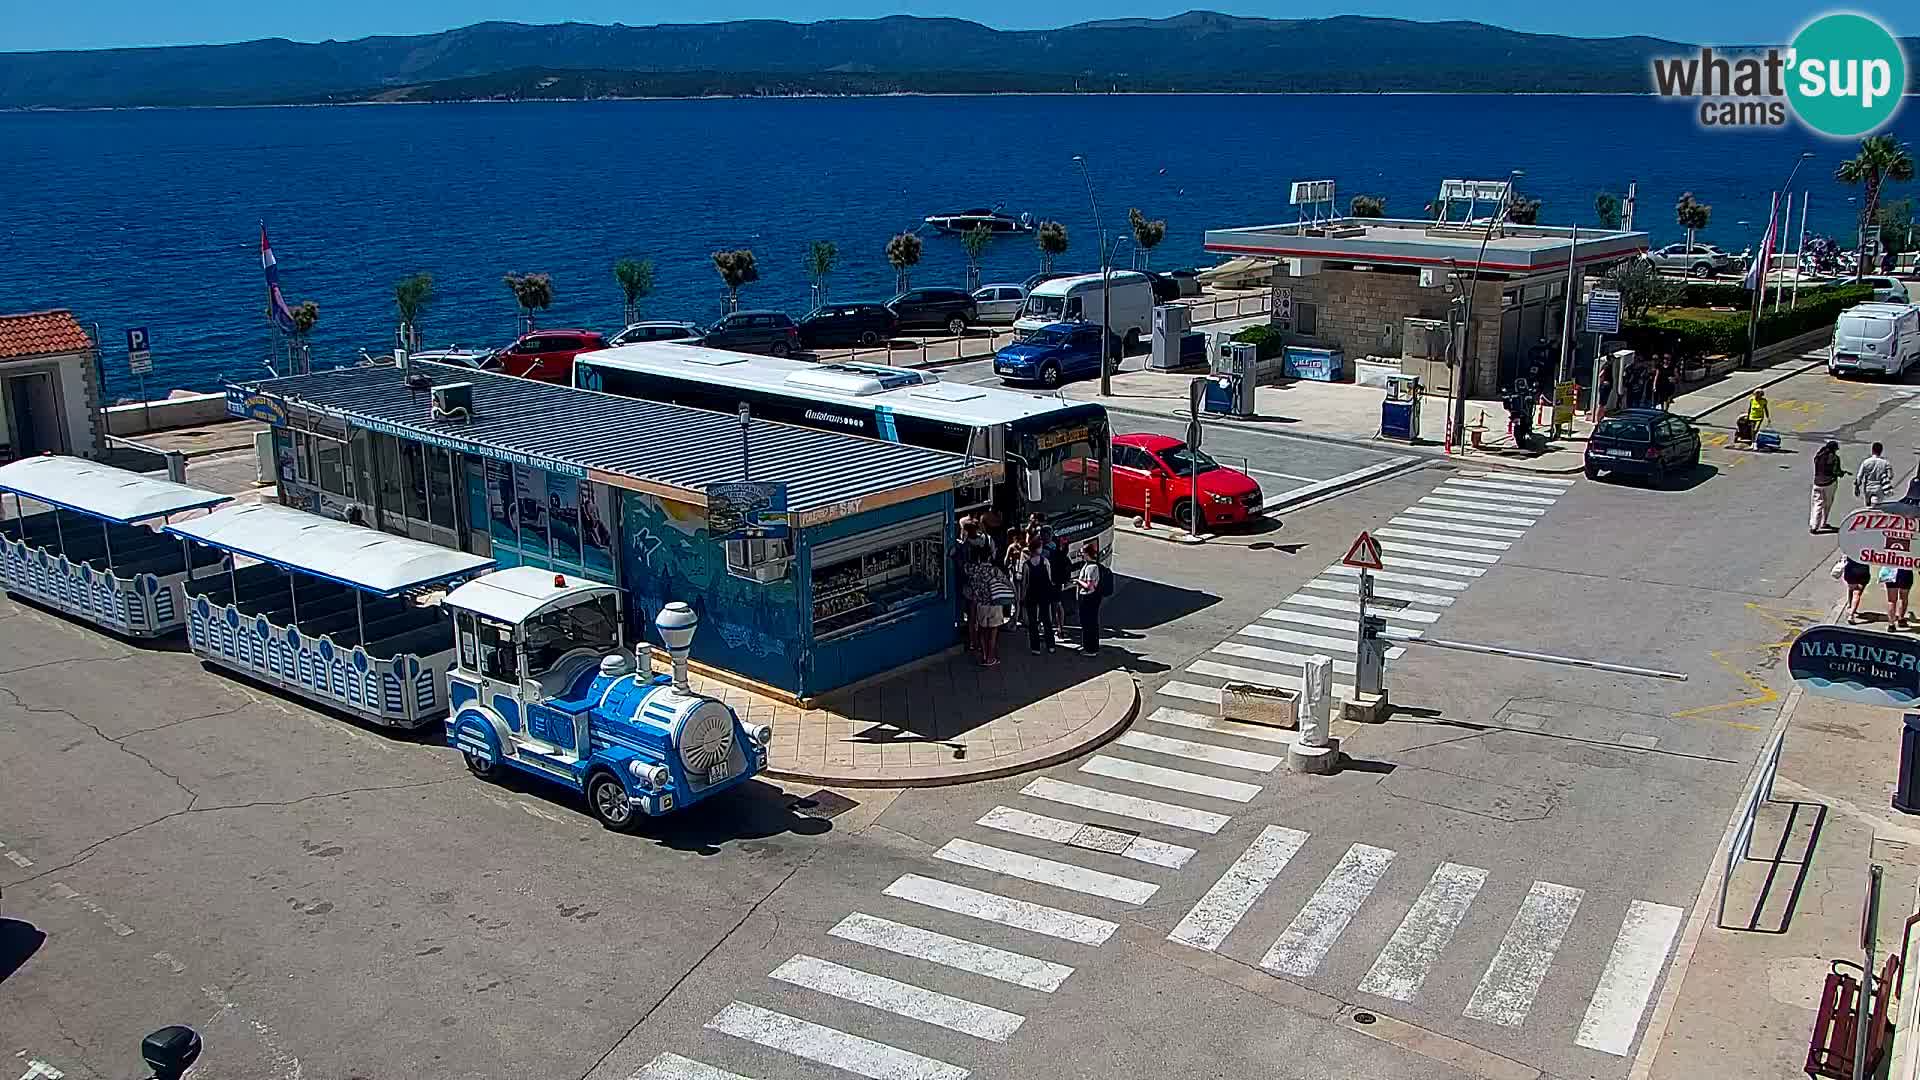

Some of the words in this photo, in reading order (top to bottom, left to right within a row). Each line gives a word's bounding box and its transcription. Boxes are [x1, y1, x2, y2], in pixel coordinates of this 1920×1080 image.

[131, 331, 143, 349] P
[479, 446, 494, 457] BUS
[495, 449, 527, 464] STATION
[528, 457, 555, 471] TICKET
[556, 462, 583, 477] OFFICE
[1848, 513, 1920, 532] PIZZE
[1800, 641, 1920, 672] MARINER
[1871, 664, 1897, 679] bar
